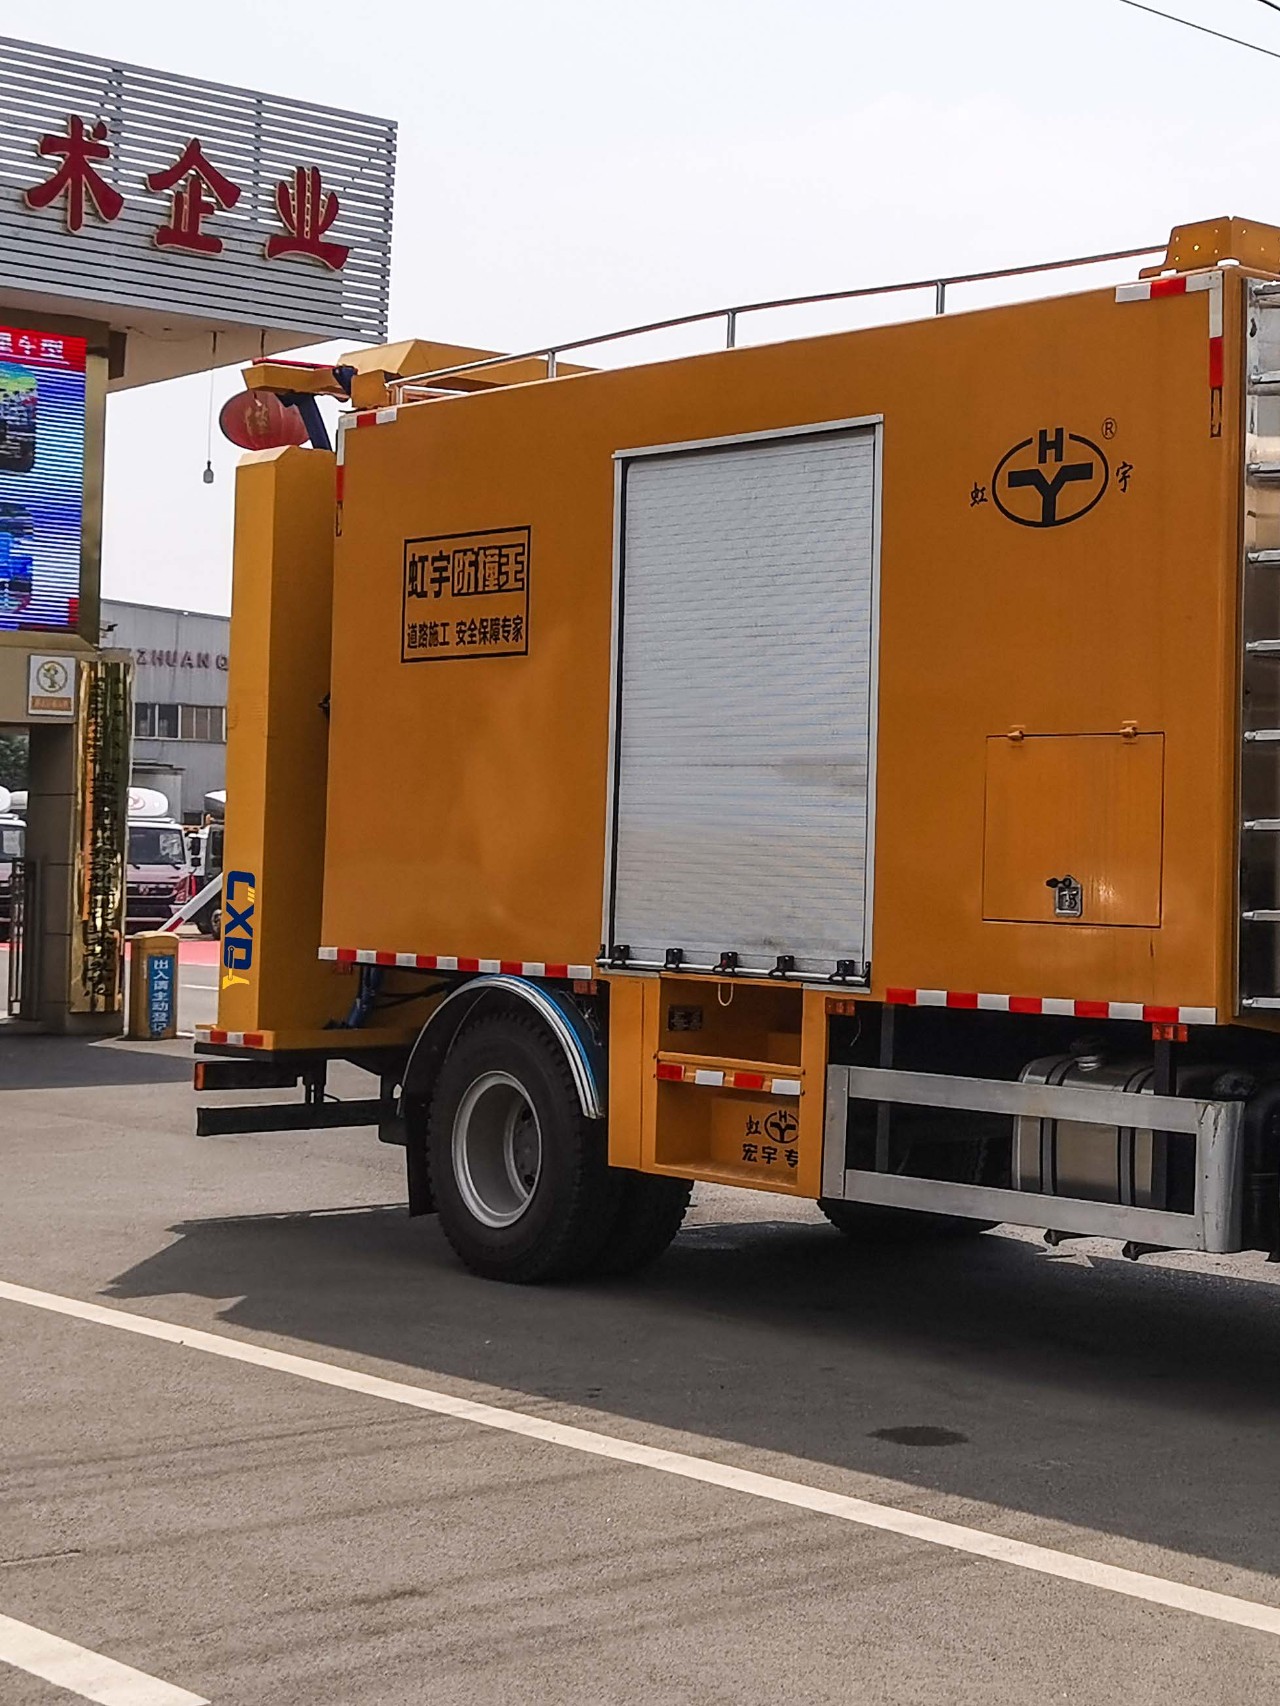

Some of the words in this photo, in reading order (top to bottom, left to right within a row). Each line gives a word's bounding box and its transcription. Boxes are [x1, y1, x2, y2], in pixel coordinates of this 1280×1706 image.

[24, 113, 351, 271] 术企业
[407, 621, 450, 649] 道路施工
[455, 615, 523, 646] 安全保障专家
